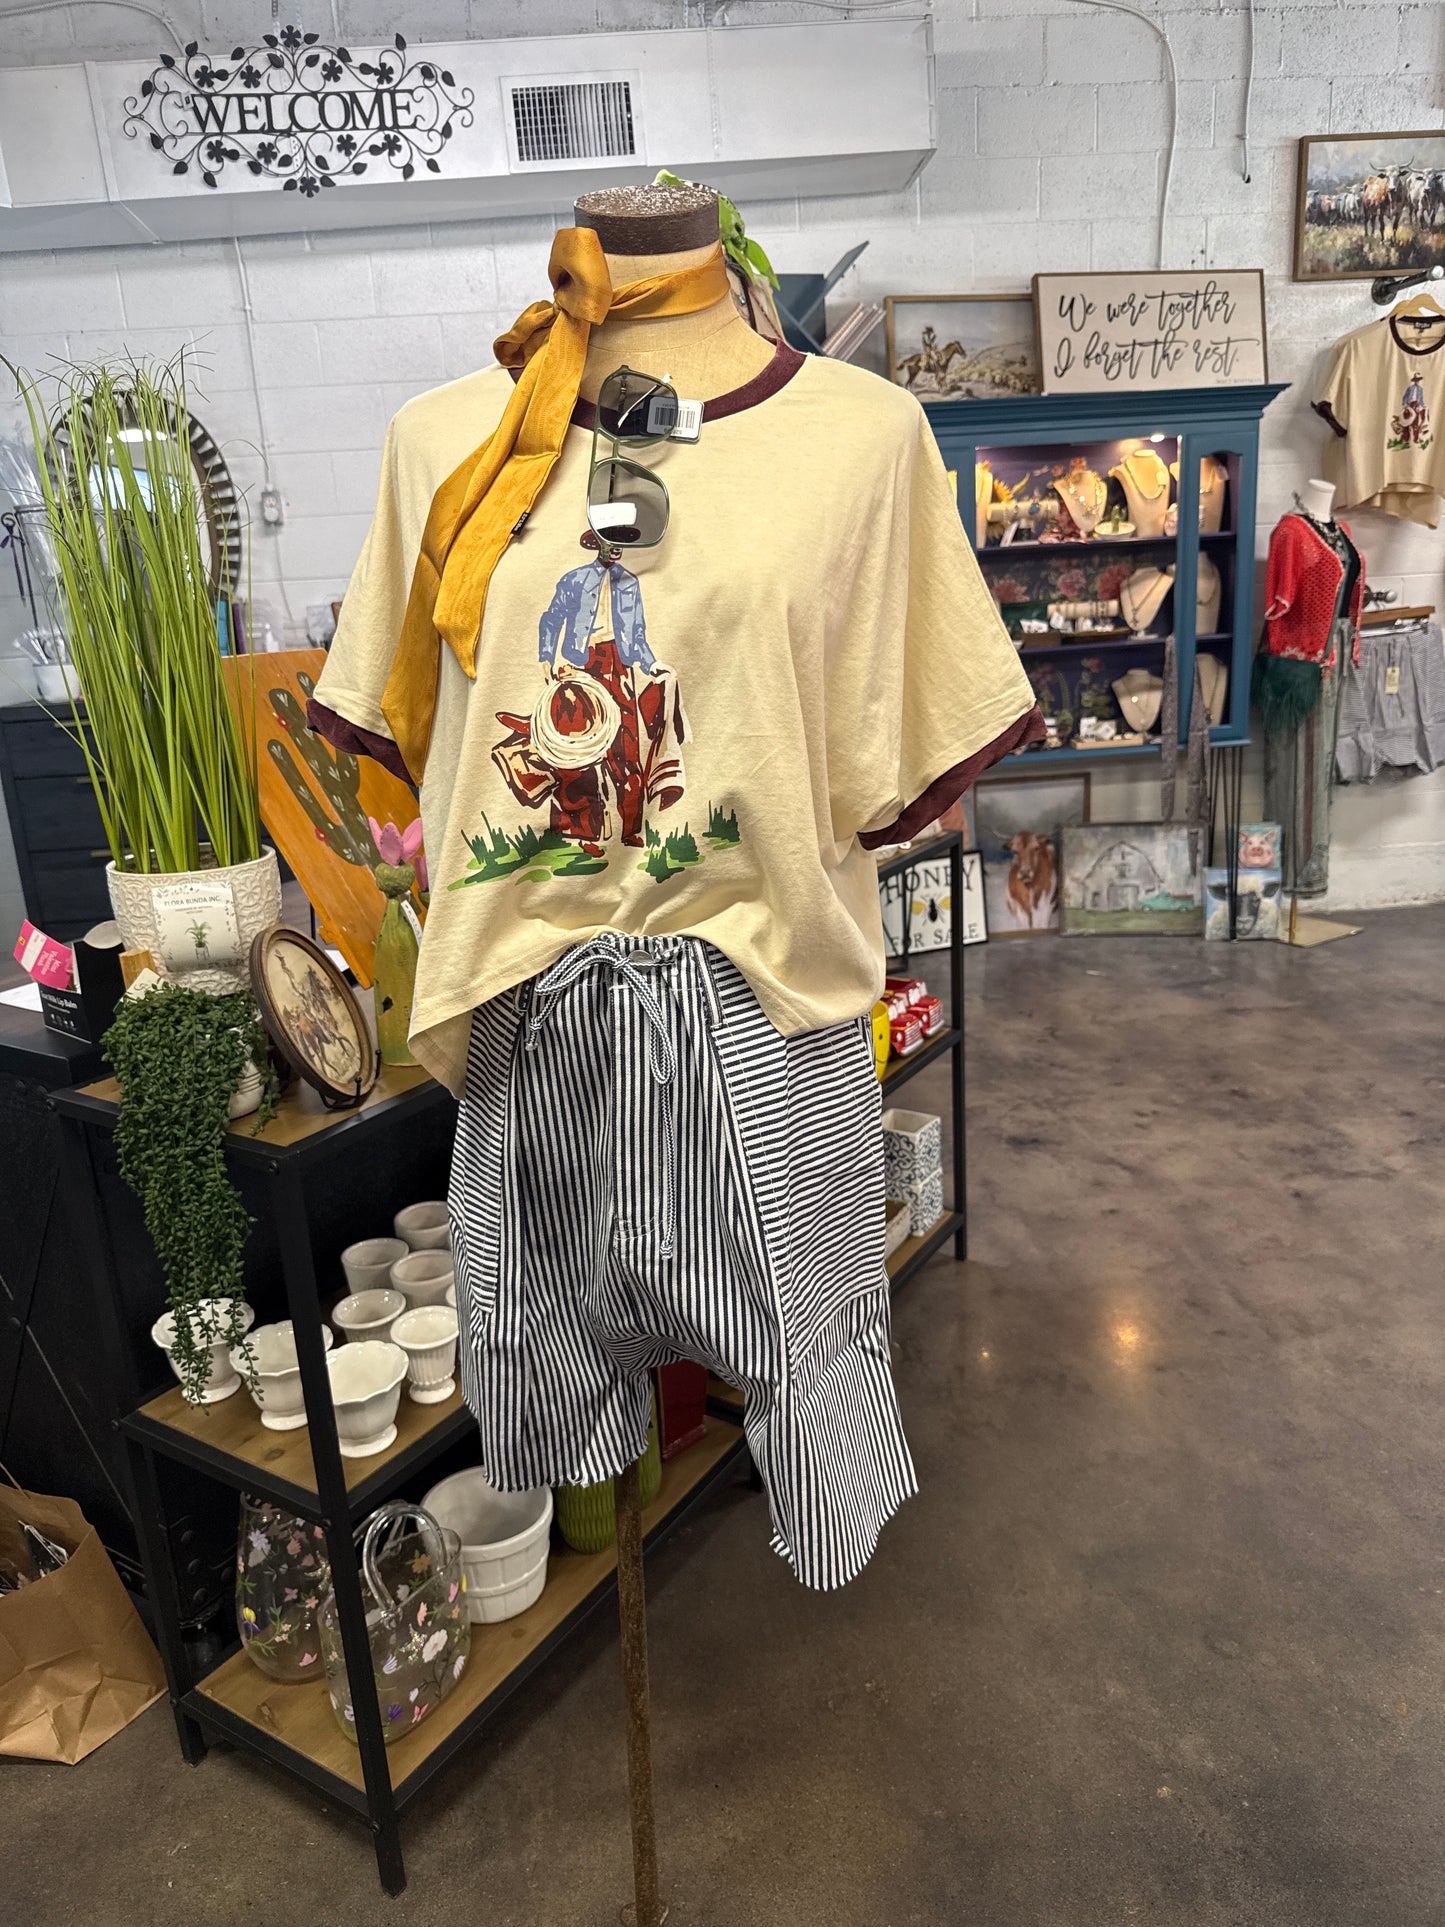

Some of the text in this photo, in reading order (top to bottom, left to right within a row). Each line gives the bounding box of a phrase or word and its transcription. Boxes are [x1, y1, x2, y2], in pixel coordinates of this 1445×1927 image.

[190, 89, 418, 134] WELCOME
[1058, 280, 1236, 332] We were together
[1054, 337, 1075, 378] I
[1083, 331, 1144, 381] forget
[1149, 329, 1188, 379] the
[164, 899, 184, 907] FLORA
[185, 896, 208, 905] BUNDA
[886, 859, 976, 905] HONEY
[891, 923, 979, 951] FR SAE
